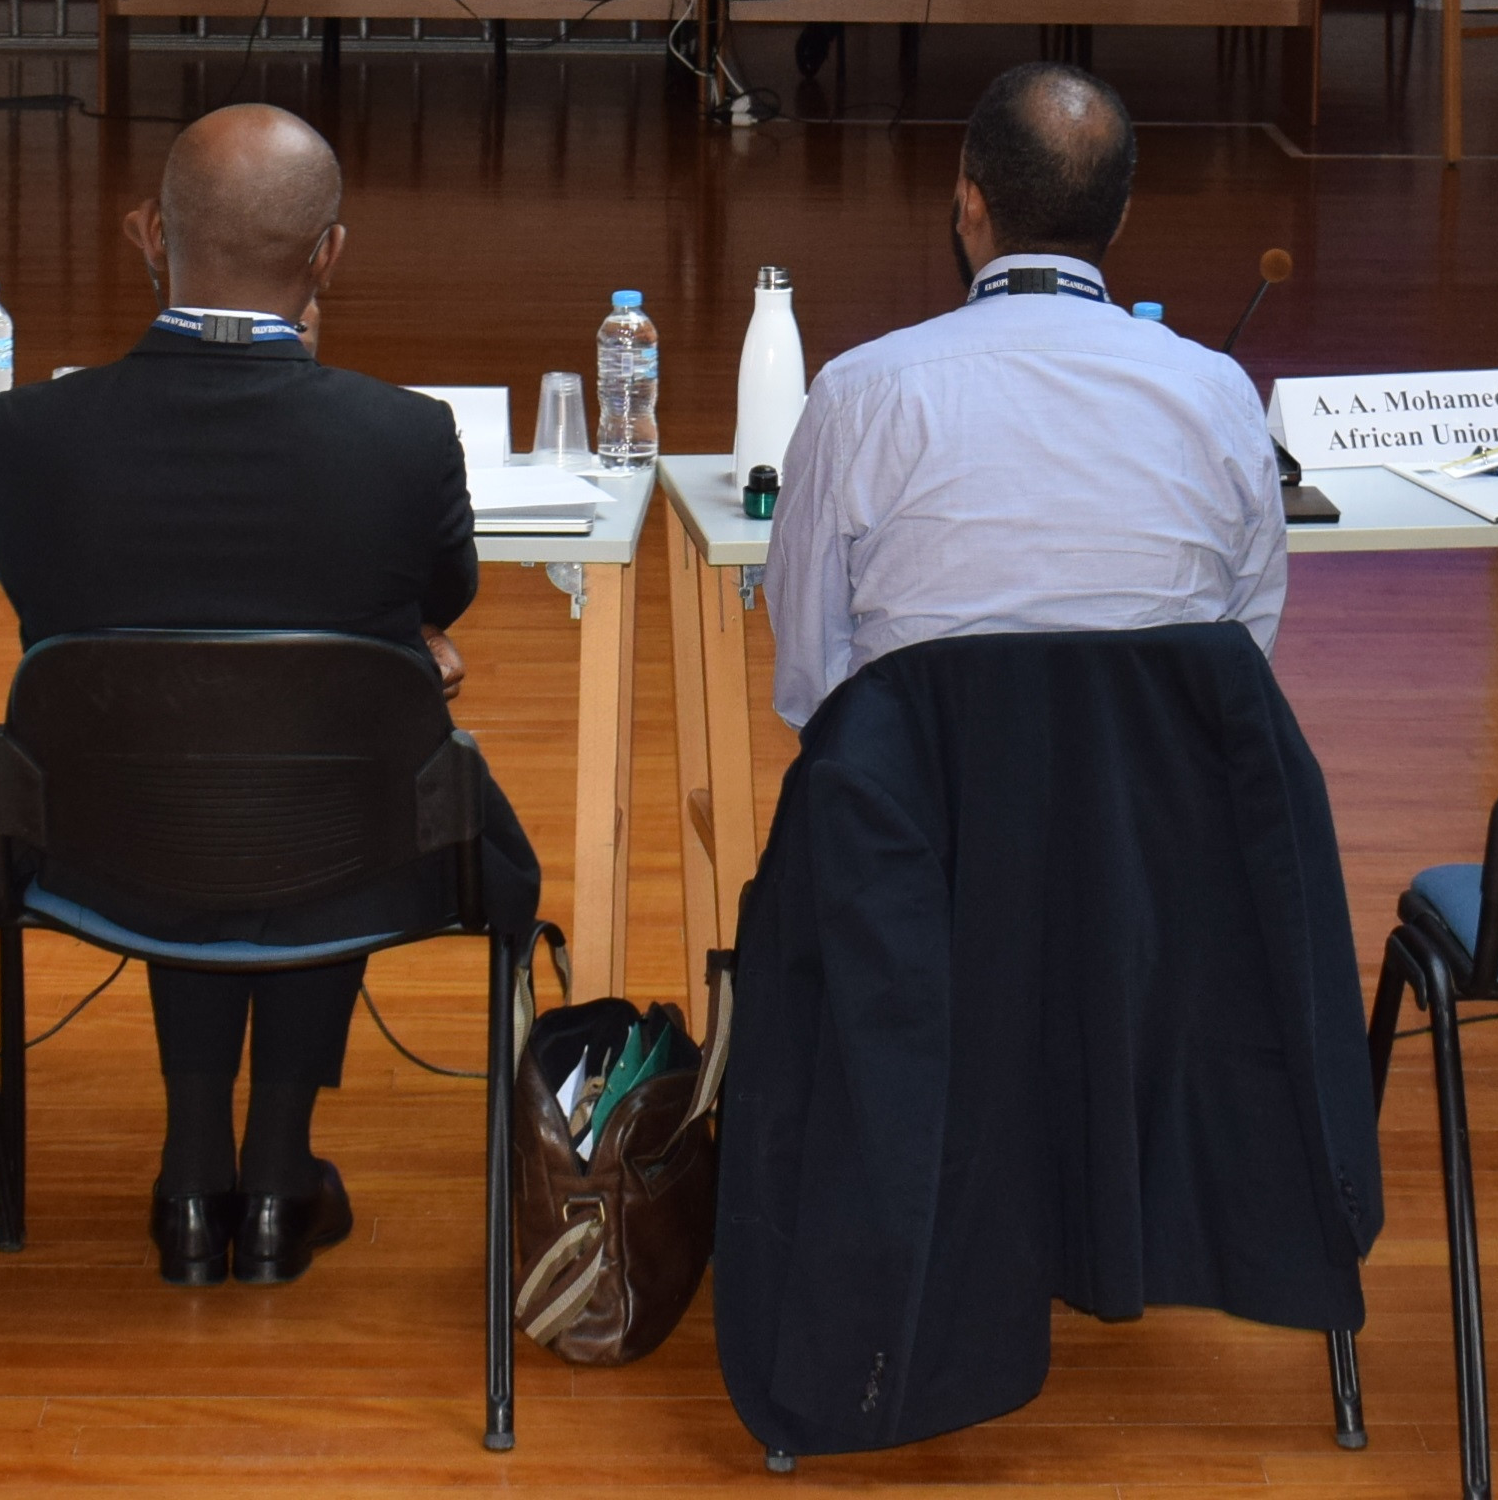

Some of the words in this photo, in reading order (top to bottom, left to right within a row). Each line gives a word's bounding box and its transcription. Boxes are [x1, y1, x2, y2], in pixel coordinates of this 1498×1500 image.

[1313, 395, 1340, 416] A.
[1349, 393, 1376, 414] A.
[1328, 427, 1424, 451] African
